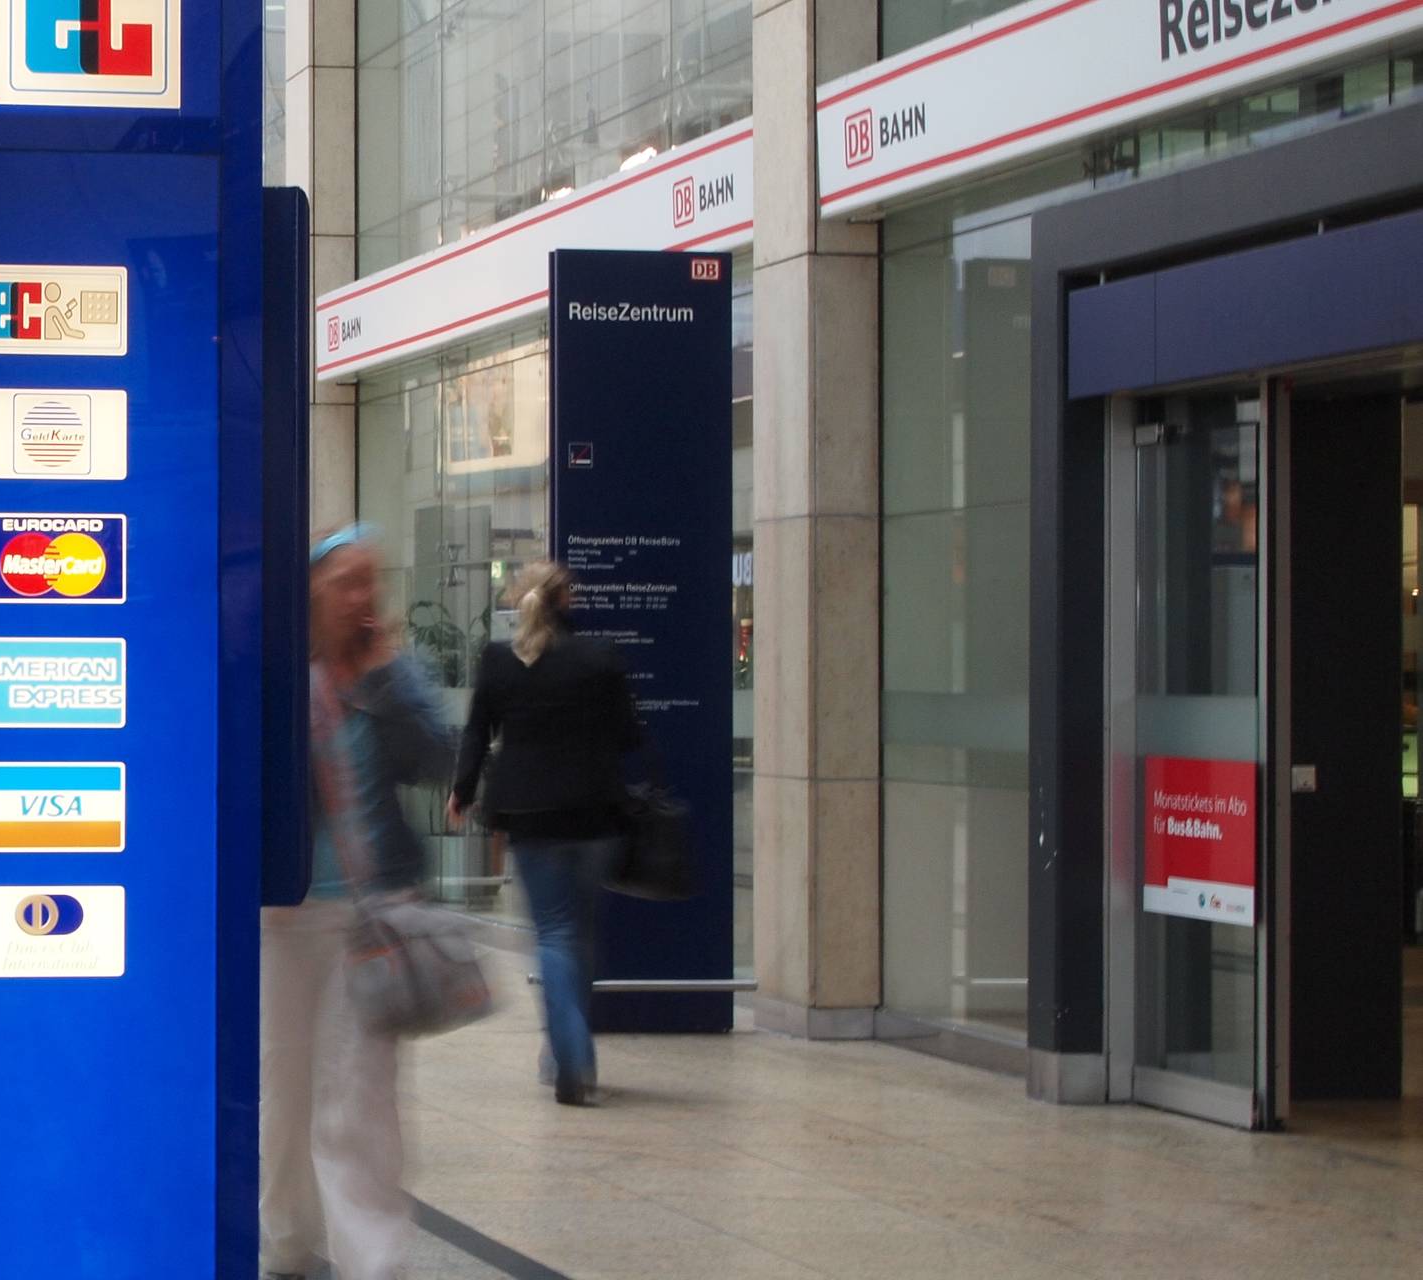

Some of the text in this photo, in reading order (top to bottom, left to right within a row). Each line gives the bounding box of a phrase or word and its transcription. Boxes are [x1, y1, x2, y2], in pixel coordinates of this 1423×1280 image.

[847, 102, 926, 162] DB BAHN
[675, 173, 734, 222] DB BAHN
[692, 261, 719, 279] DB
[568, 302, 694, 322] ReiseZentrum
[341, 317, 362, 342] BAHN
[20, 428, 85, 441] GeldKarte
[2, 518, 104, 532] EUROCARD
[2, 554, 103, 575] MasterCard
[12, 687, 122, 706] EXPRESS
[20, 794, 83, 817] VISA
[1153, 789, 1248, 816] Monatstickets im Abo
[1153, 815, 1223, 840] für Bus&Bahn.
